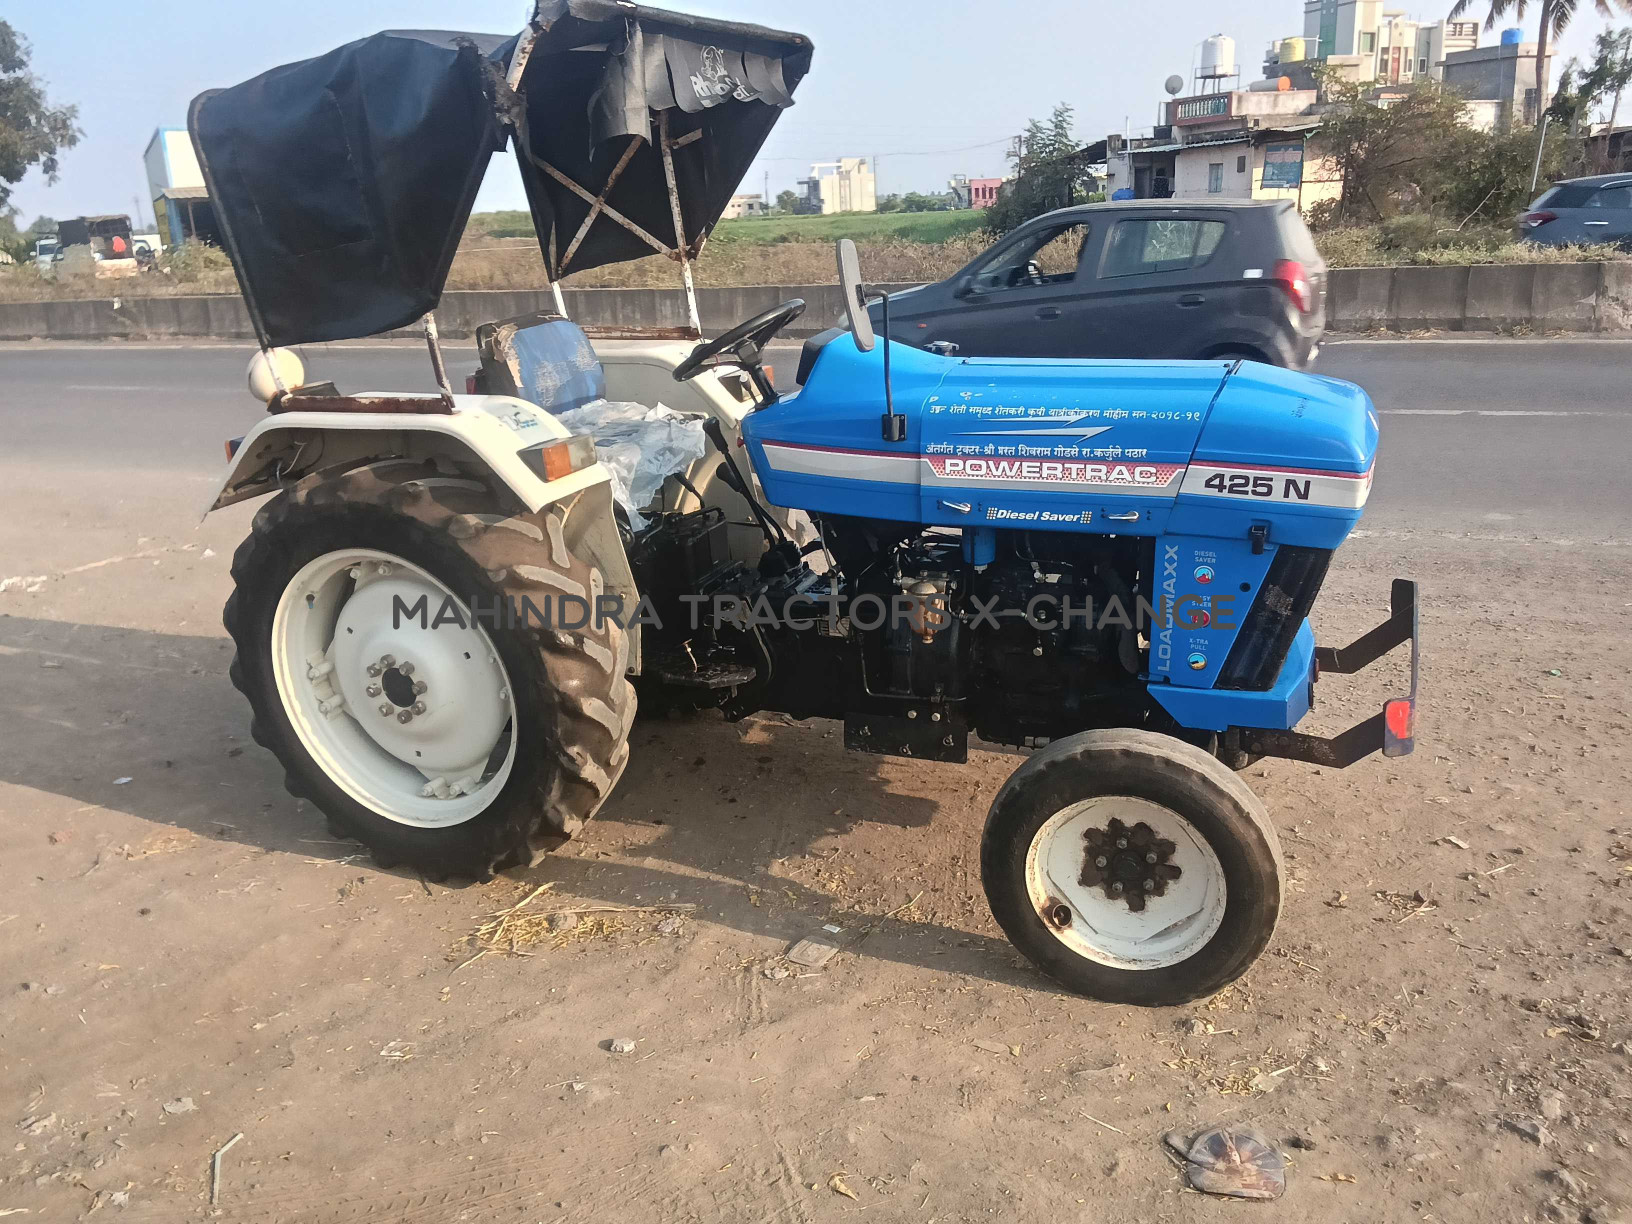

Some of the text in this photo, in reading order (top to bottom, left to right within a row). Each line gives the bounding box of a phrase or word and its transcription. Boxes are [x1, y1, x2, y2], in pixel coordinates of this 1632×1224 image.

[944, 458, 1157, 483] POWERTRAC
[1204, 473, 1312, 500] 425 N
[996, 509, 1081, 522] Diesel Saver
[1194, 550, 1217, 558] DIESEL
[1158, 544, 1179, 672] LOADMAXX
[1190, 643, 1207, 651] PULL
